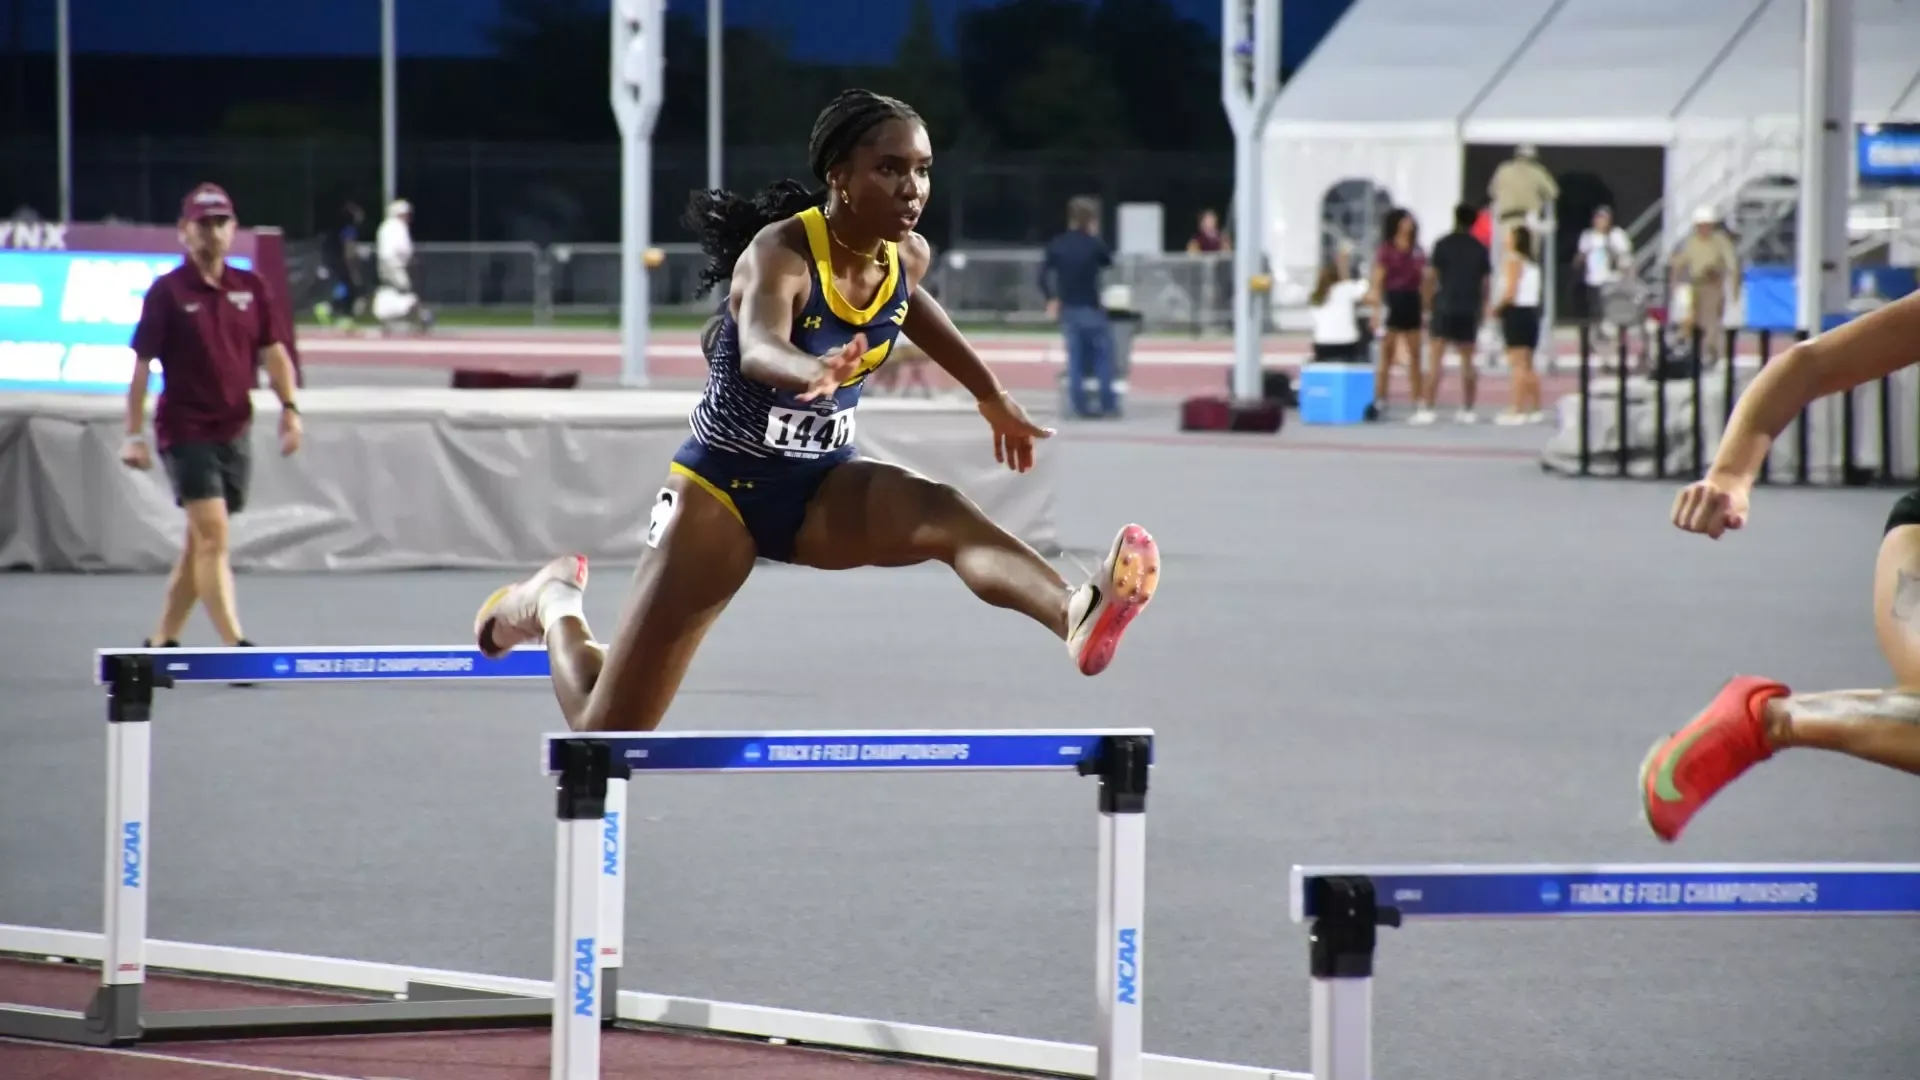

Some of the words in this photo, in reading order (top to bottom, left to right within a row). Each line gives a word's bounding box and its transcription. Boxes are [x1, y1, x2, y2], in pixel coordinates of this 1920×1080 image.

[775, 413, 849, 450] 1446
[295, 659, 331, 673] TRACK
[343, 658, 376, 672] FIELD
[377, 658, 473, 671] CHAMPIONSHIPS
[768, 745, 811, 761] TRACK
[823, 745, 859, 760] FIELD
[860, 744, 970, 760] CHAMPIONSHIPS
[123, 821, 142, 888] NCAA
[603, 811, 619, 876] NCAA
[1570, 883, 1620, 905] TRACK
[1636, 882, 1681, 904] FIELD
[1683, 882, 1817, 903] CHAMPIONSHIPS
[575, 937, 596, 1017] NCAA
[1117, 928, 1137, 1005] NCAA
